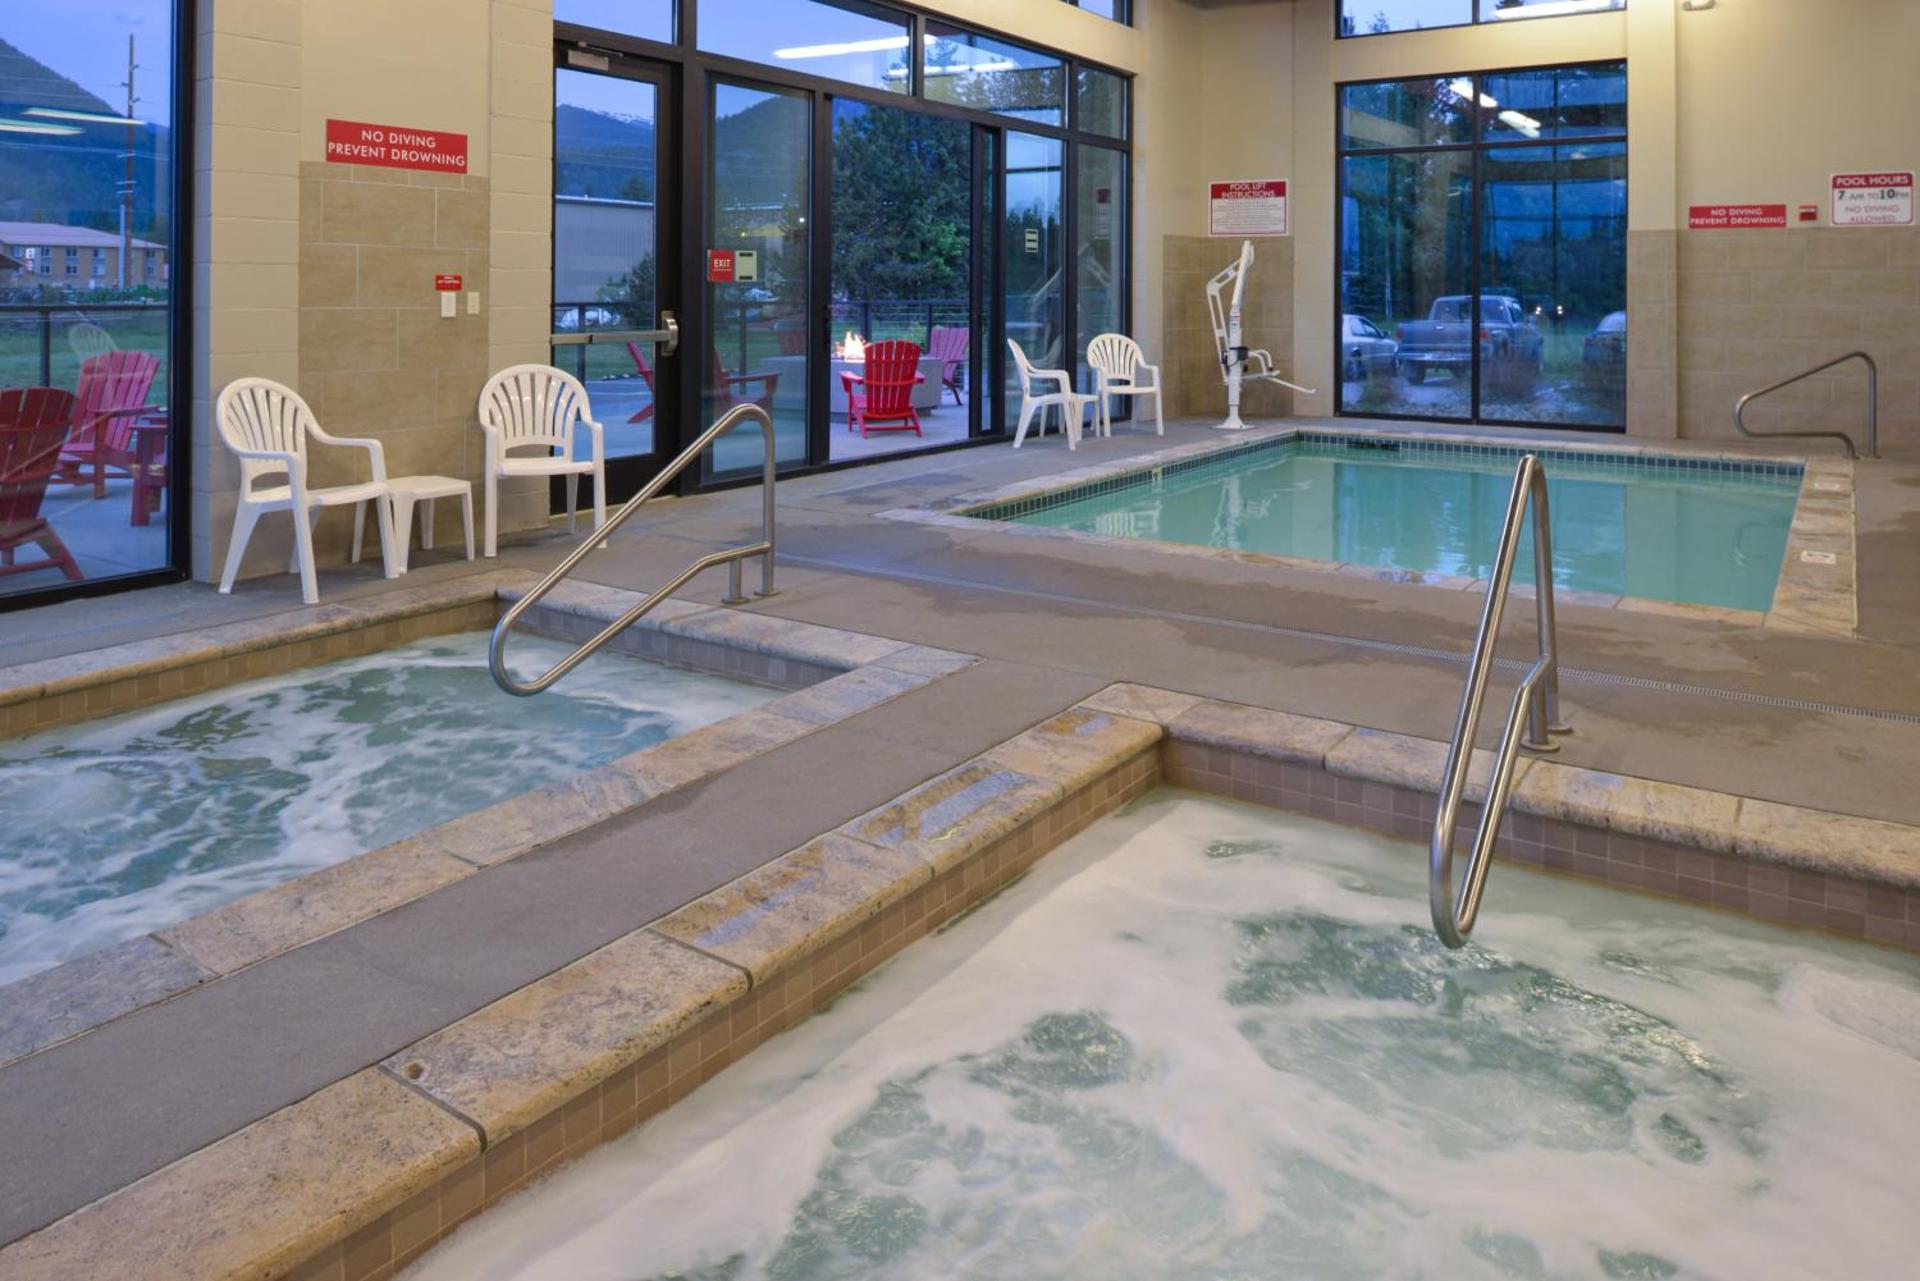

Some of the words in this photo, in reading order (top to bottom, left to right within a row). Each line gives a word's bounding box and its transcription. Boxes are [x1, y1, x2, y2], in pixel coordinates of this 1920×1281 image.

[361, 130, 383, 142] NO
[389, 133, 436, 148] DIVING
[328, 142, 386, 159] PREVENT
[392, 149, 465, 166] DROWNING
[1837, 177, 1866, 186] POOL
[1869, 176, 1908, 184] HOURS
[1838, 190, 1846, 200] 7
[1729, 208, 1762, 216] DIVING
[713, 258, 731, 268] EXIT
